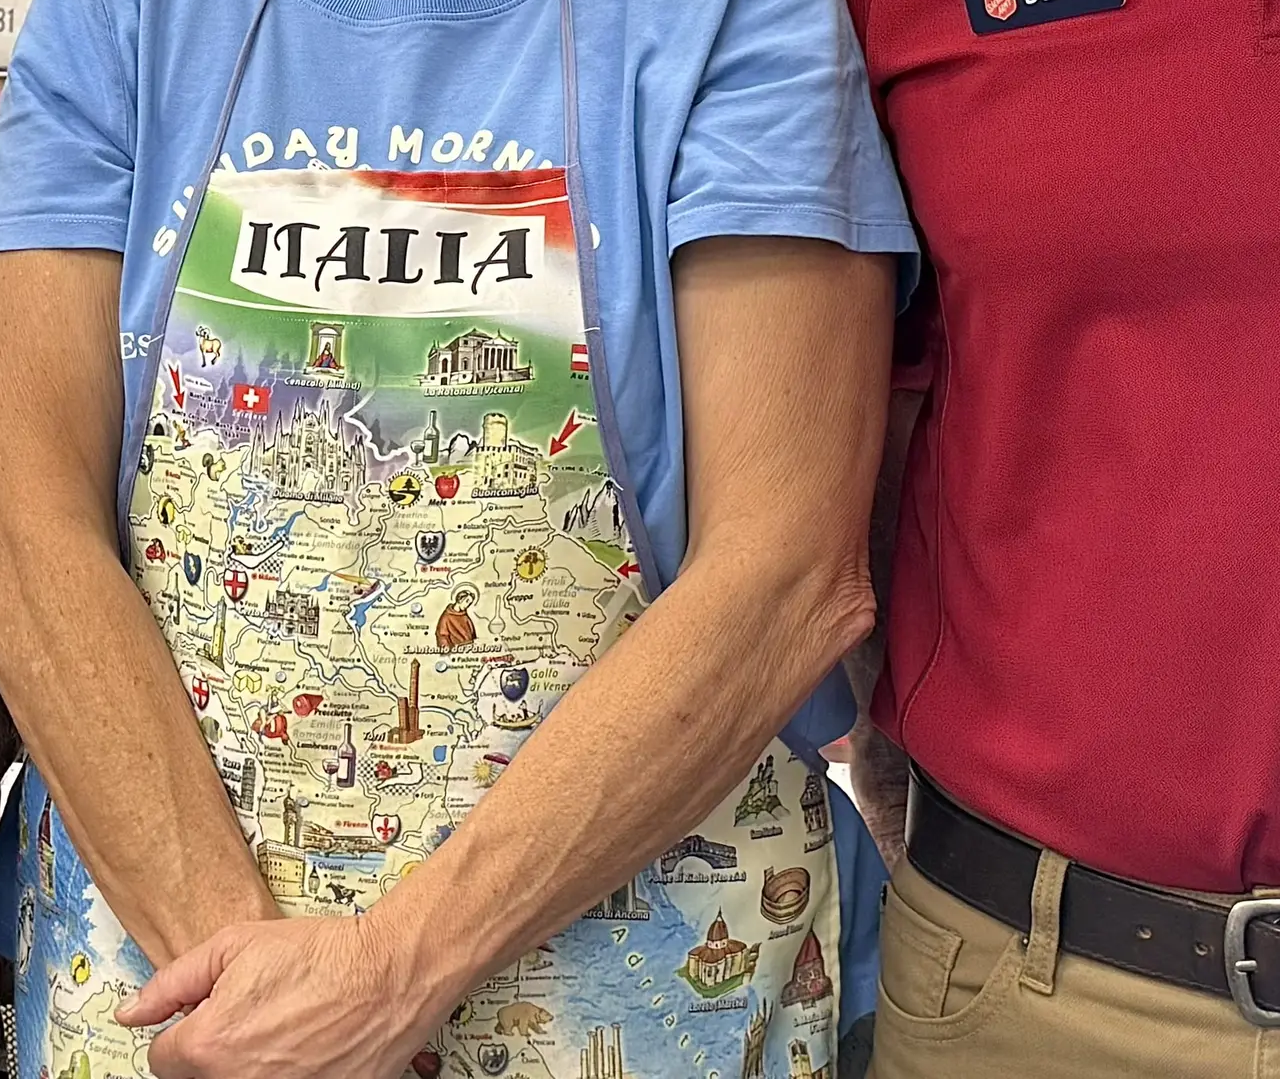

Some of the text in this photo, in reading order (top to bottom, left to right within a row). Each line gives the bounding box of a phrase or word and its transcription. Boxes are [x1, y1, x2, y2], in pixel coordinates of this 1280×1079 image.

[388, 124, 554, 171] MORN
[240, 222, 533, 296] ITALIA
[424, 386, 436, 397] La
[436, 386, 479, 397] Rotonda
[273, 487, 304, 500] Duomo
[314, 492, 344, 503] Milano
[471, 486, 539, 499] Buonconsiglio
[530, 668, 559, 679] Golfo
[530, 682, 539, 692] di
[614, 910, 649, 920] Ancona
